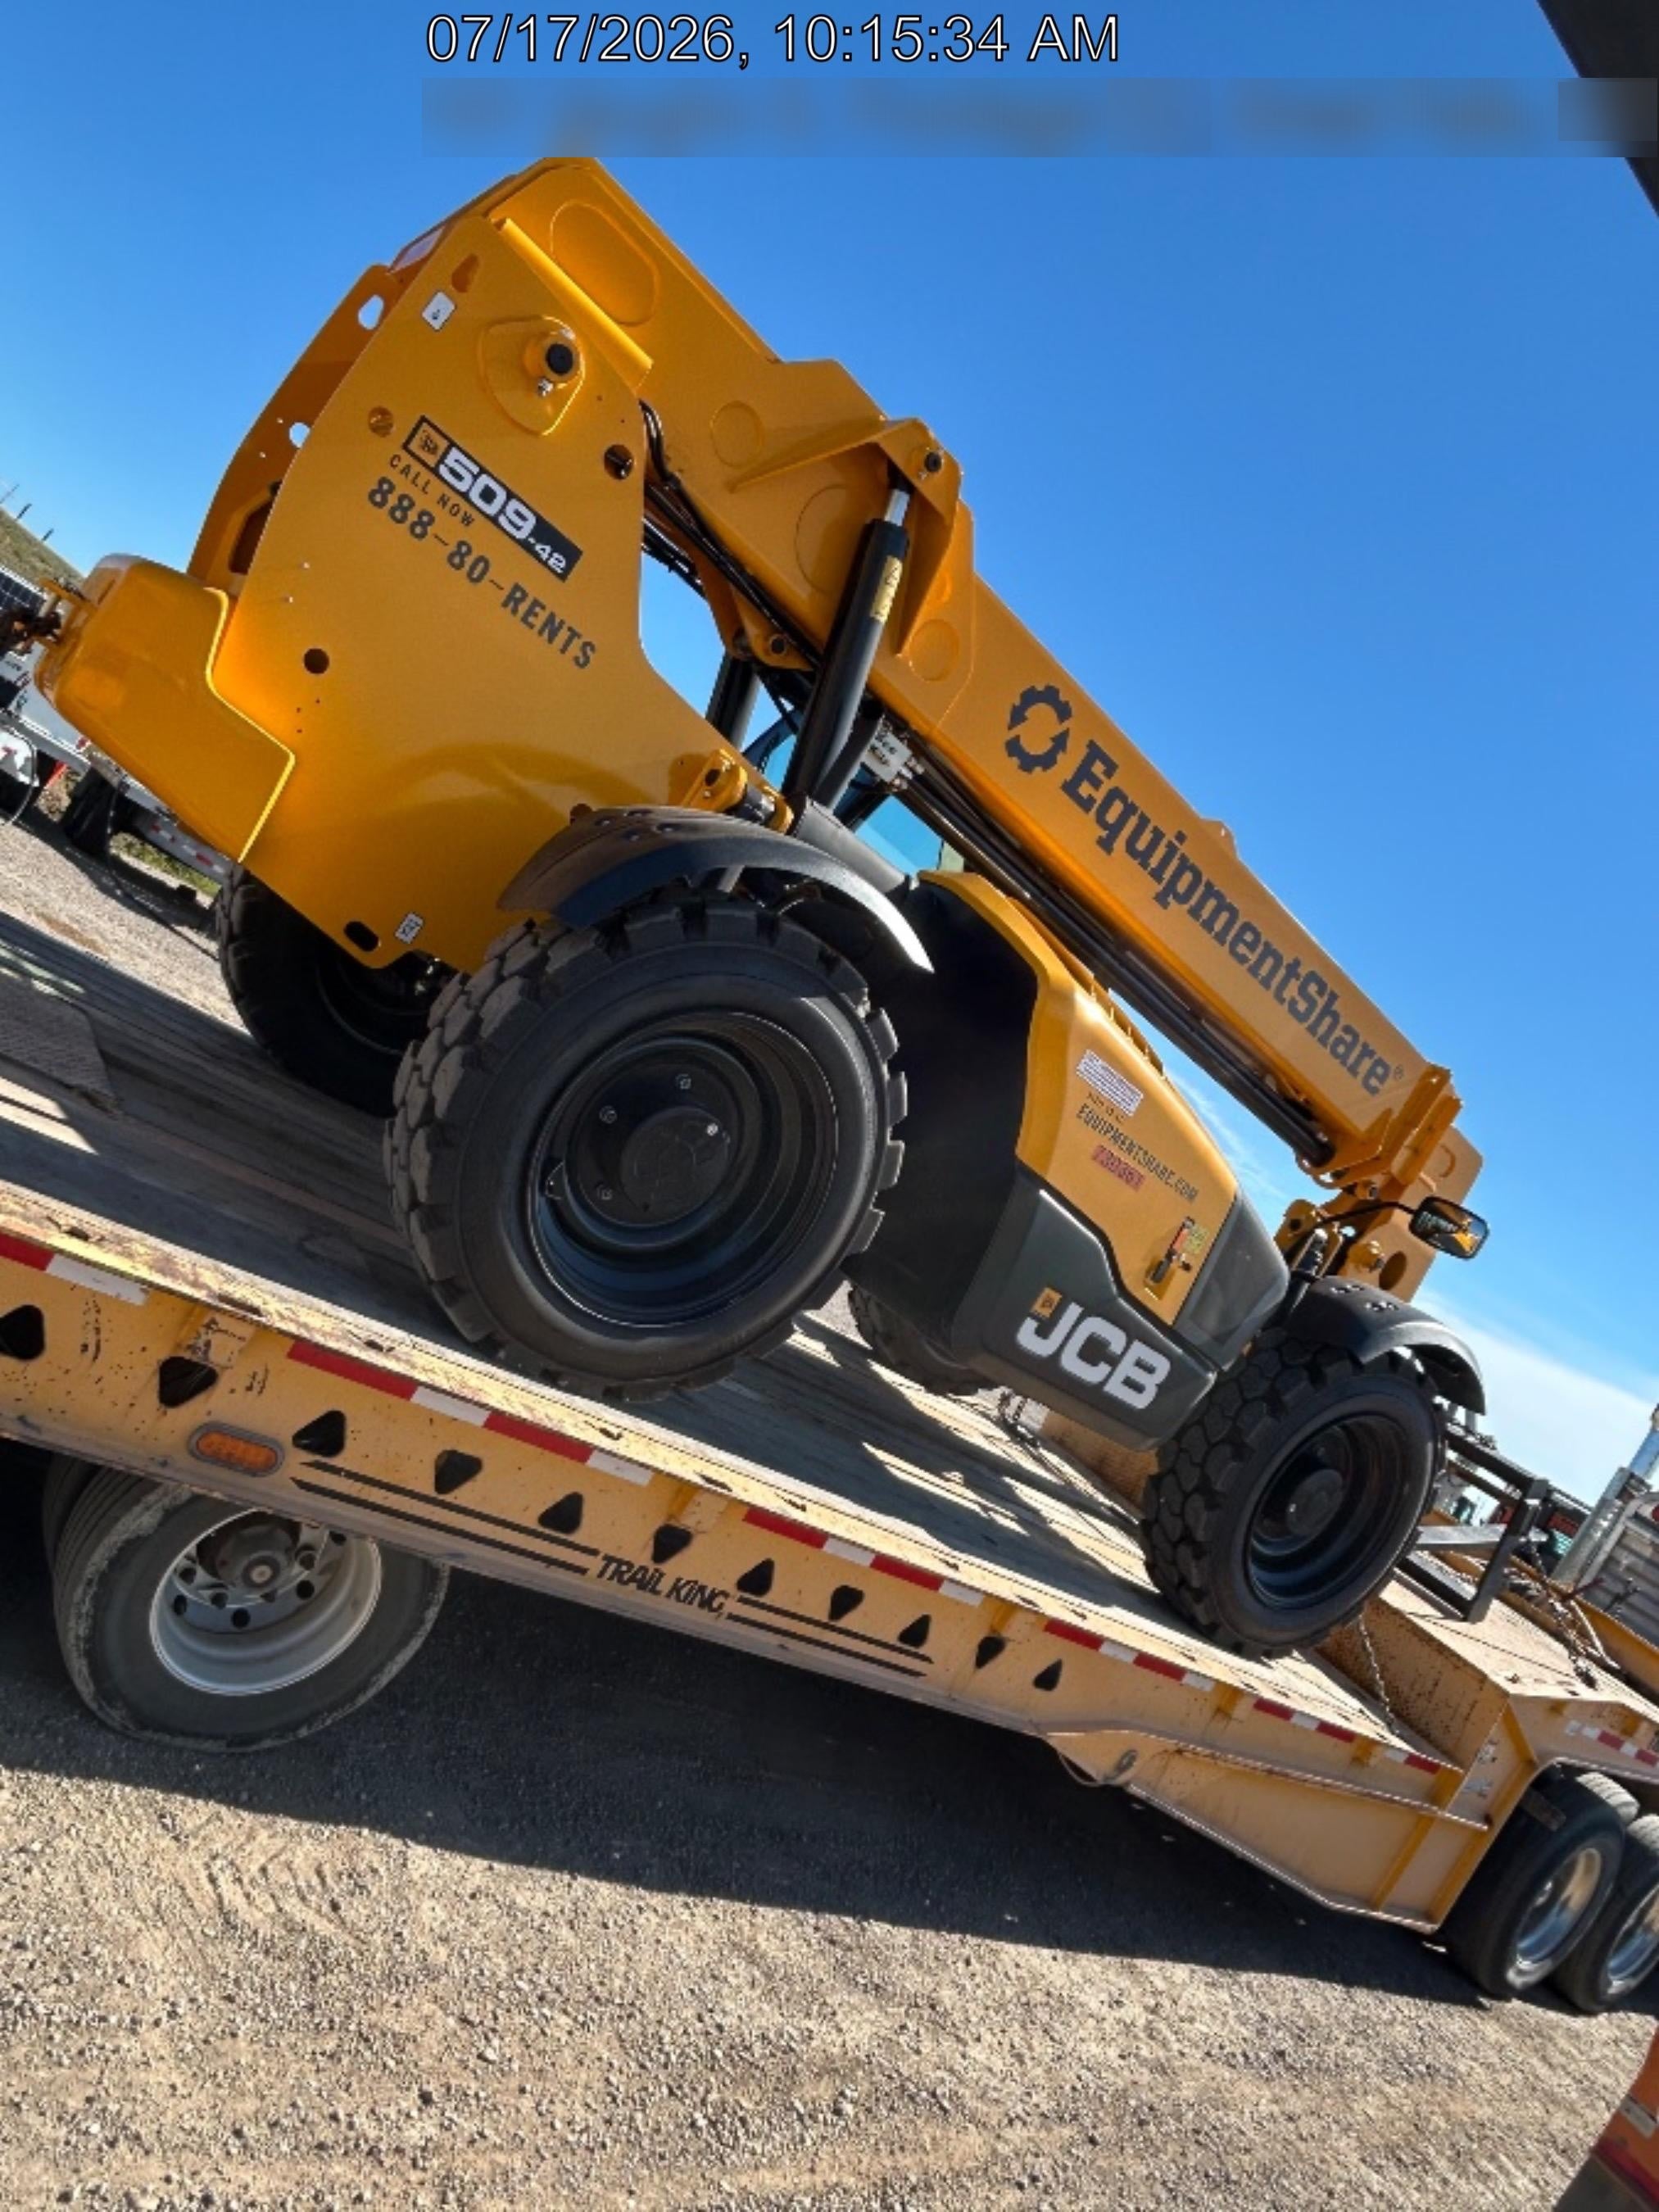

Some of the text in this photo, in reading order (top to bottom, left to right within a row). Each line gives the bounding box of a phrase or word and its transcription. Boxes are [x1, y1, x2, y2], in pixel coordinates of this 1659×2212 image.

[389, 453, 475, 528] CALL NOW
[368, 476, 596, 669] 888-80-RENTS
[1016, 1302, 1171, 1410] JCB
[596, 1553, 730, 1613] TRAIL KING
